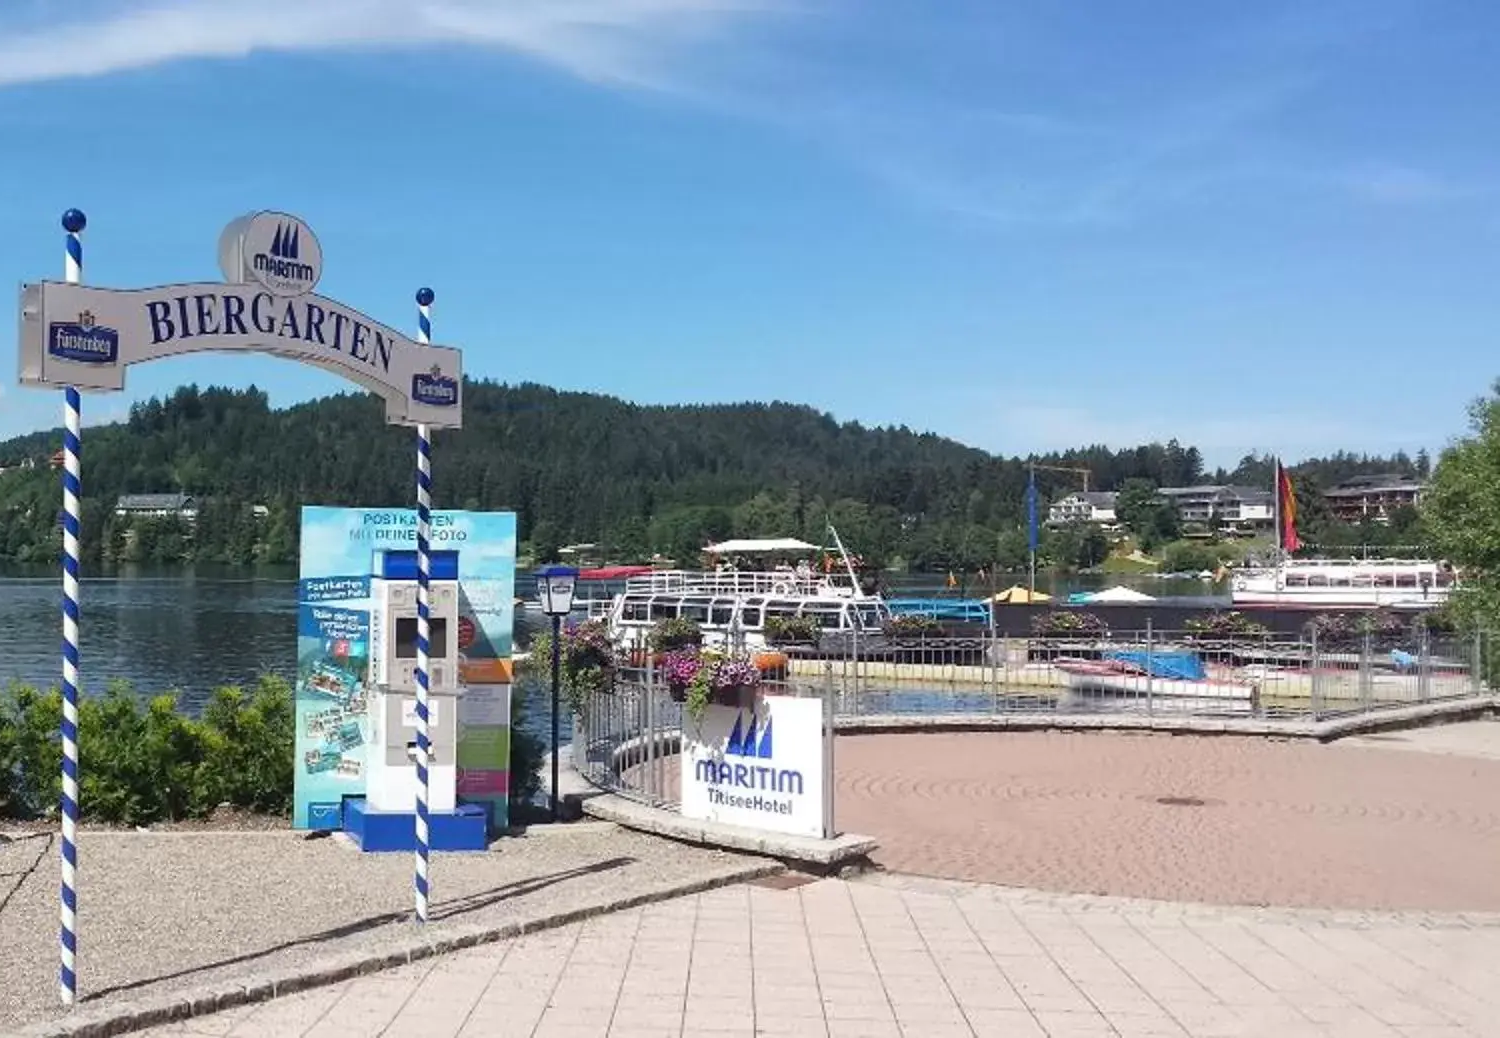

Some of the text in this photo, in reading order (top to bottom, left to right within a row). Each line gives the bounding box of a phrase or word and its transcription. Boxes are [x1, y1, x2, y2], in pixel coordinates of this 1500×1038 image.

[253, 253, 313, 281] MARITIM
[145, 292, 396, 374] BIERGARTEN
[363, 513, 455, 526] POSTKATEN
[431, 530, 467, 541] FOTO
[696, 759, 804, 795] MARITIM
[708, 788, 793, 815] TitiseeHotel
